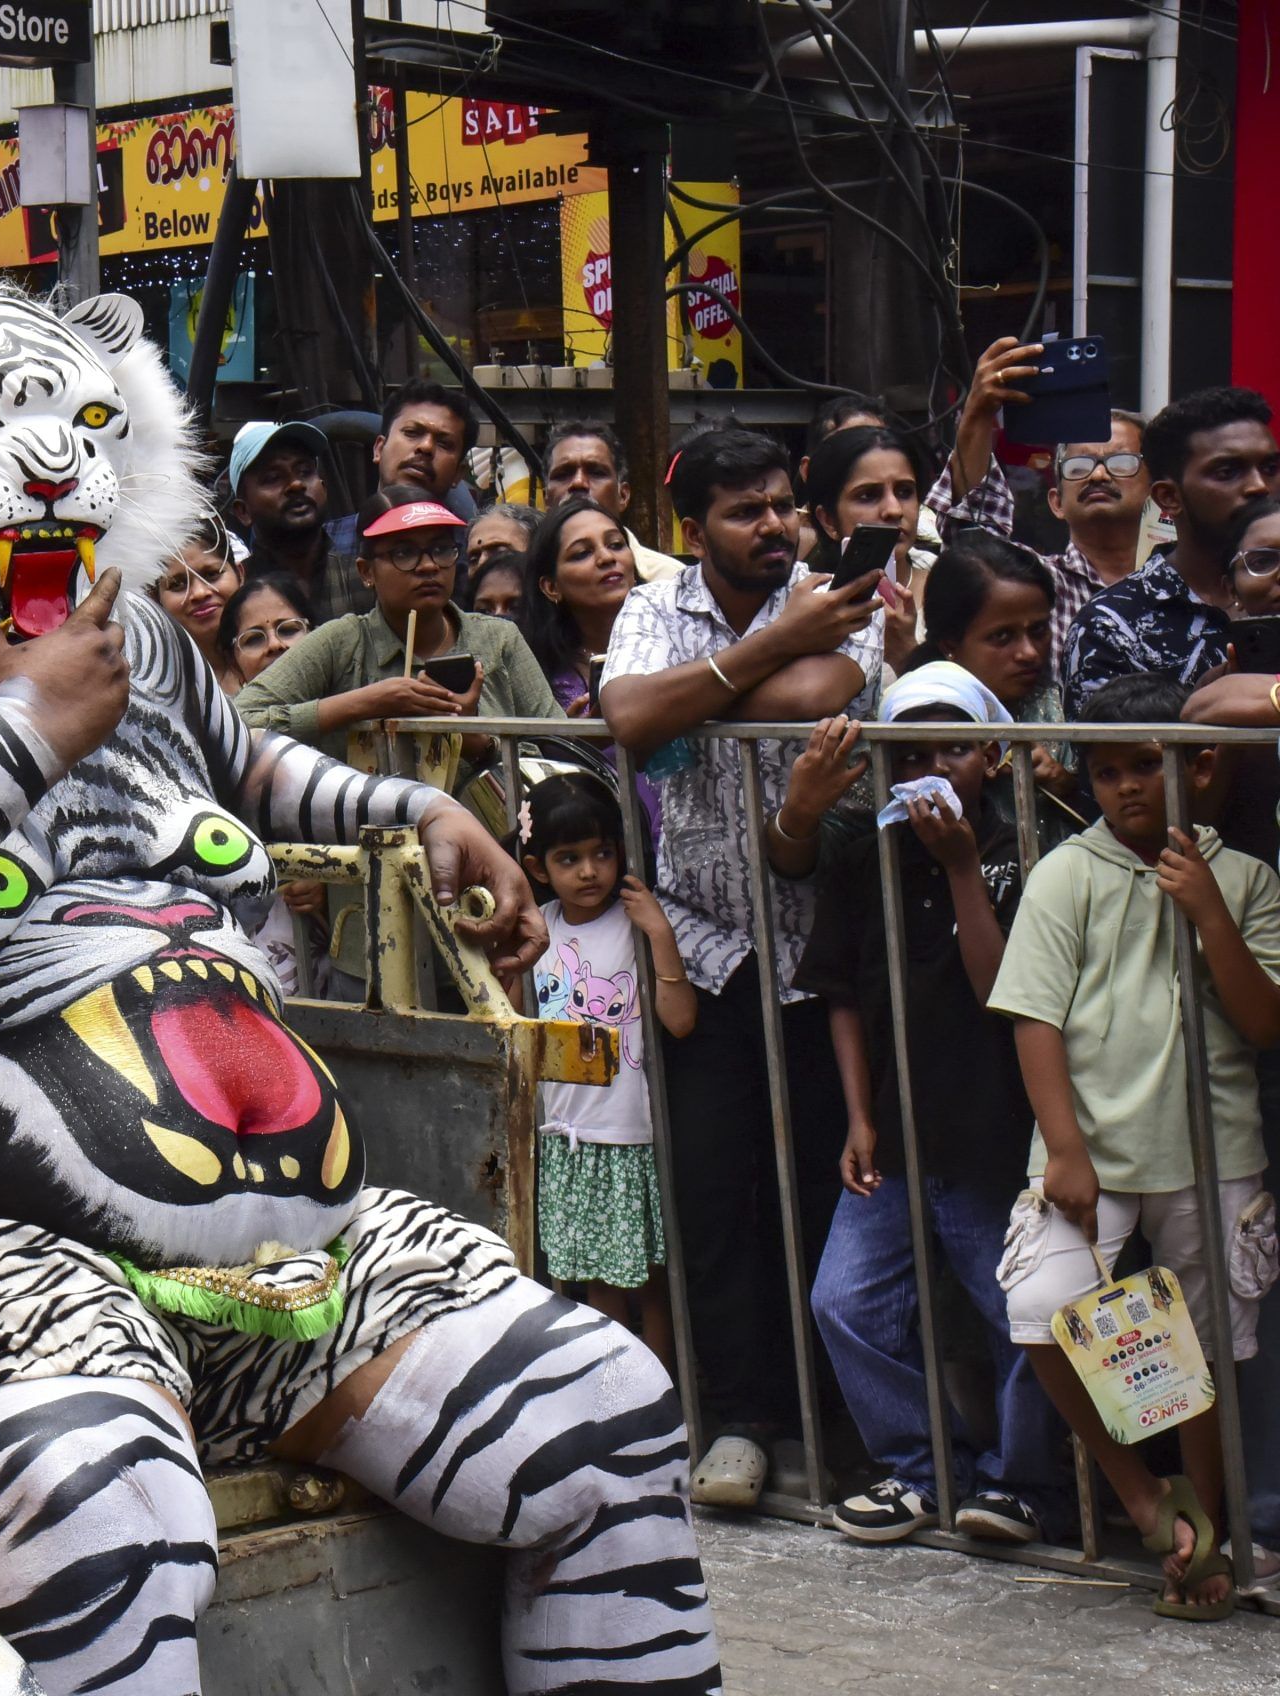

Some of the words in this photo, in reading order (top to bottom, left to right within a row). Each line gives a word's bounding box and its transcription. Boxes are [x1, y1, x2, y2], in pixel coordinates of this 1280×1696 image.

[370, 188, 399, 211] ids
[426, 180, 473, 204] Boys
[480, 164, 579, 196] Available
[144, 209, 211, 241] Below
[1138, 1406, 1162, 1428] GO
[1162, 1398, 1189, 1420] SUN
